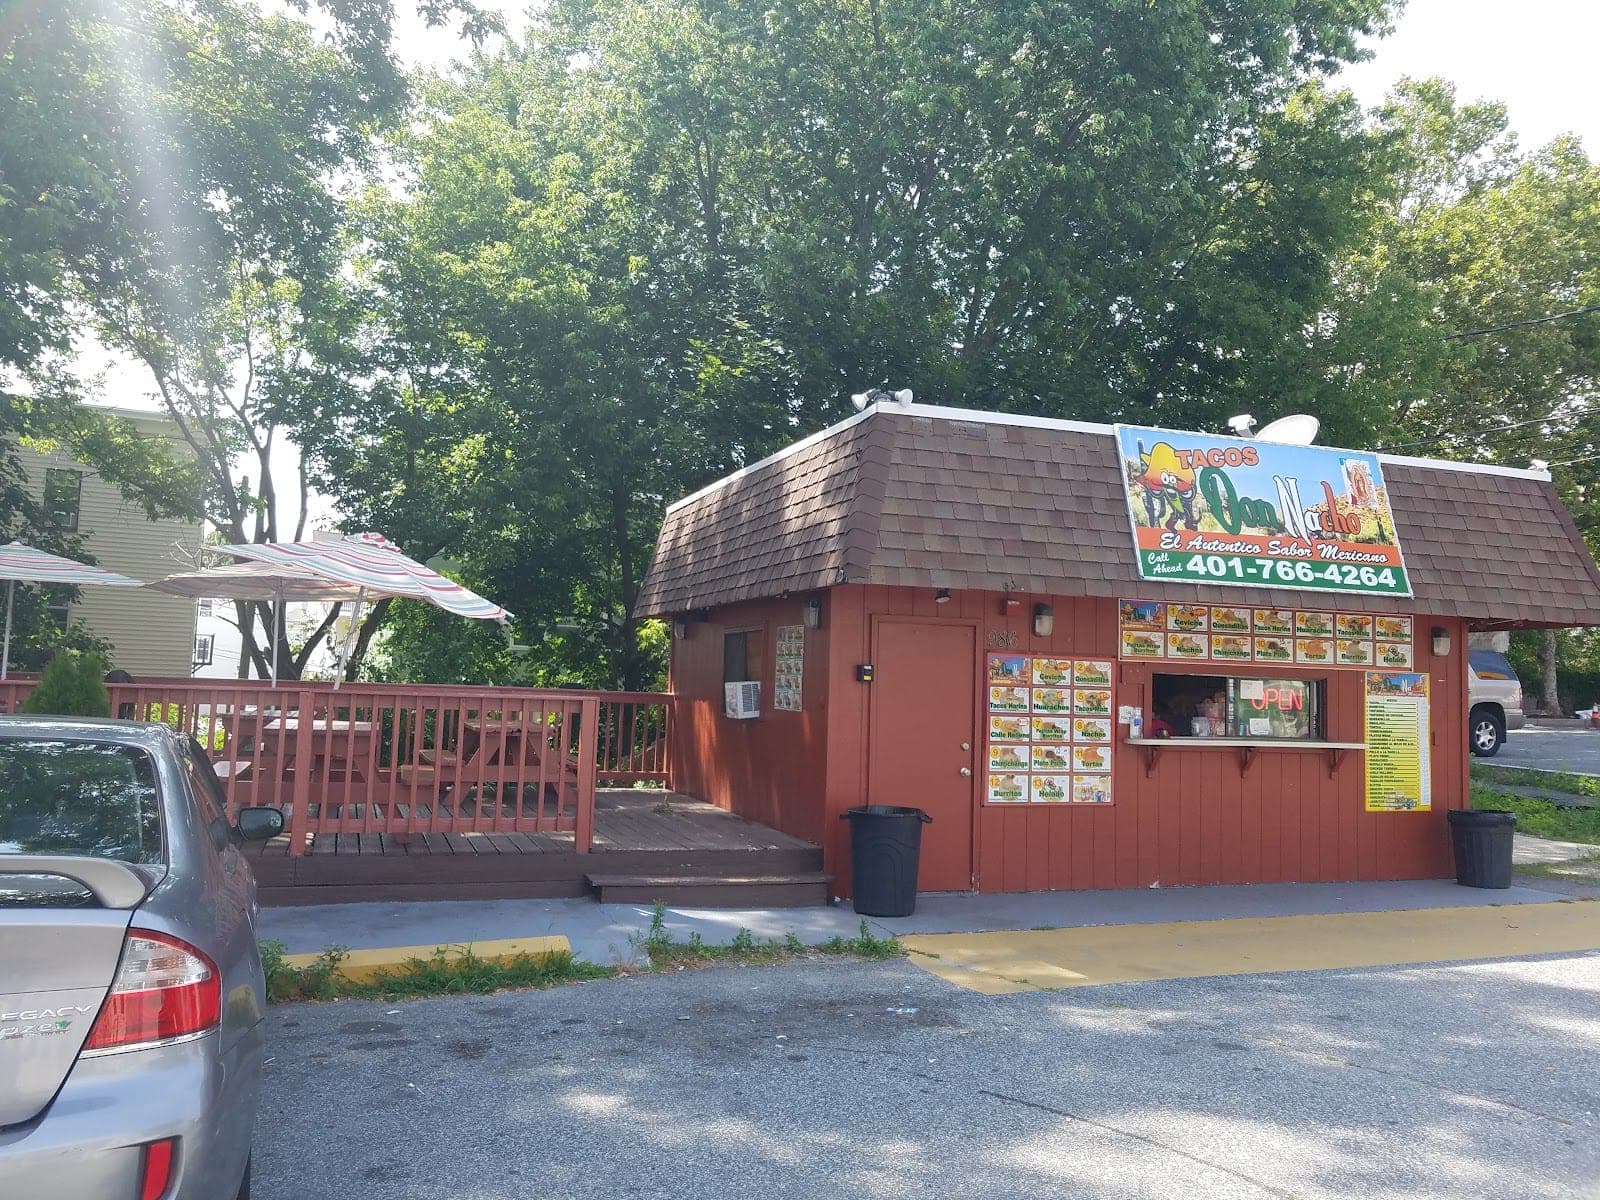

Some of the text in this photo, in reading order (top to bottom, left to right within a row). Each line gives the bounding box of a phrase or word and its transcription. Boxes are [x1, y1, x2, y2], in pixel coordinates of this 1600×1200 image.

[1174, 446, 1260, 469] TACOS
[1199, 466, 1361, 547] Don Nacho
[1148, 552, 1170, 564] Call
[1160, 532, 1388, 563] El Autentico Sabor Mexicano
[1153, 562, 1183, 574] Ahead
[1186, 554, 1397, 588] 401-766-4264
[1250, 688, 1303, 711] OPEN
